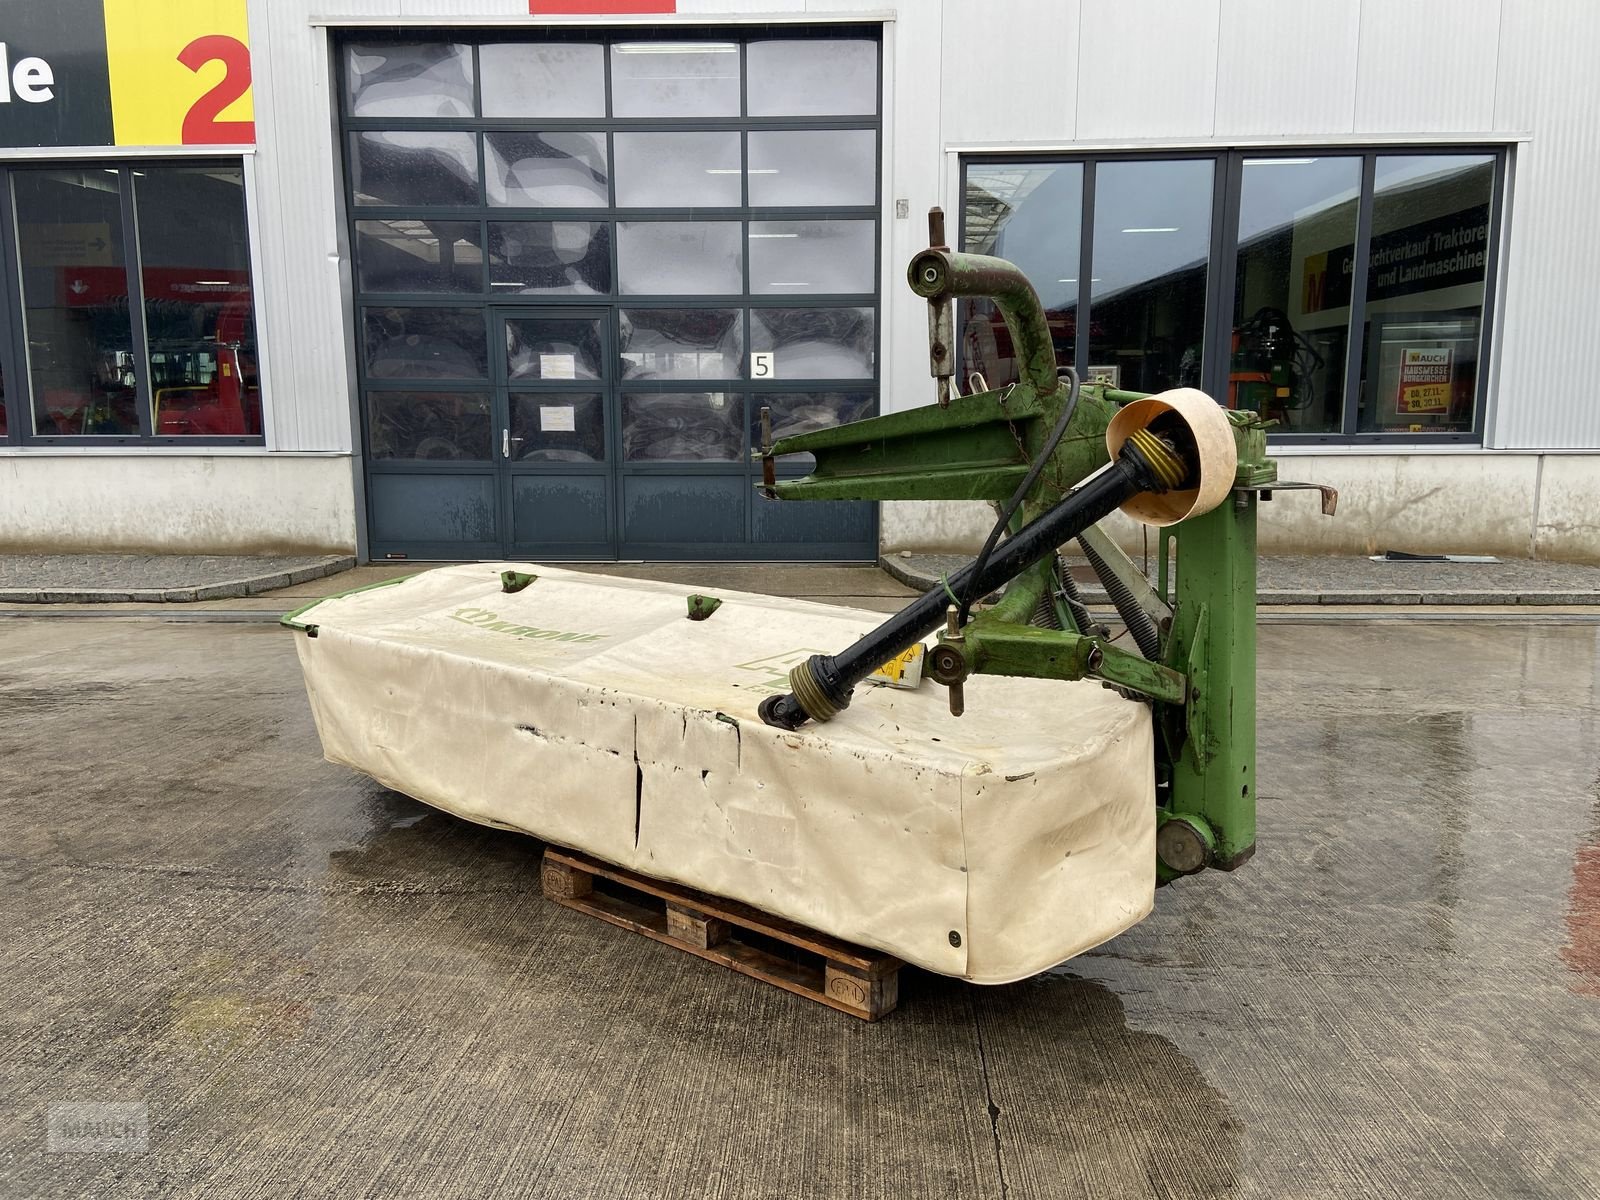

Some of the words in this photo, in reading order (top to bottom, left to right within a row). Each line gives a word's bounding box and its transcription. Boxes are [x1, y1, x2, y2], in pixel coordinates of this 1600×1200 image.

[176, 34, 256, 145] 2
[1342, 237, 1431, 275] Geuchtverkauf
[1377, 271, 1396, 287] und
[755, 356, 768, 376] 5
[1411, 354, 1446, 362] MAUCH
[1404, 366, 1448, 375] HAUSMESSE
[477, 621, 612, 643] KRONE
